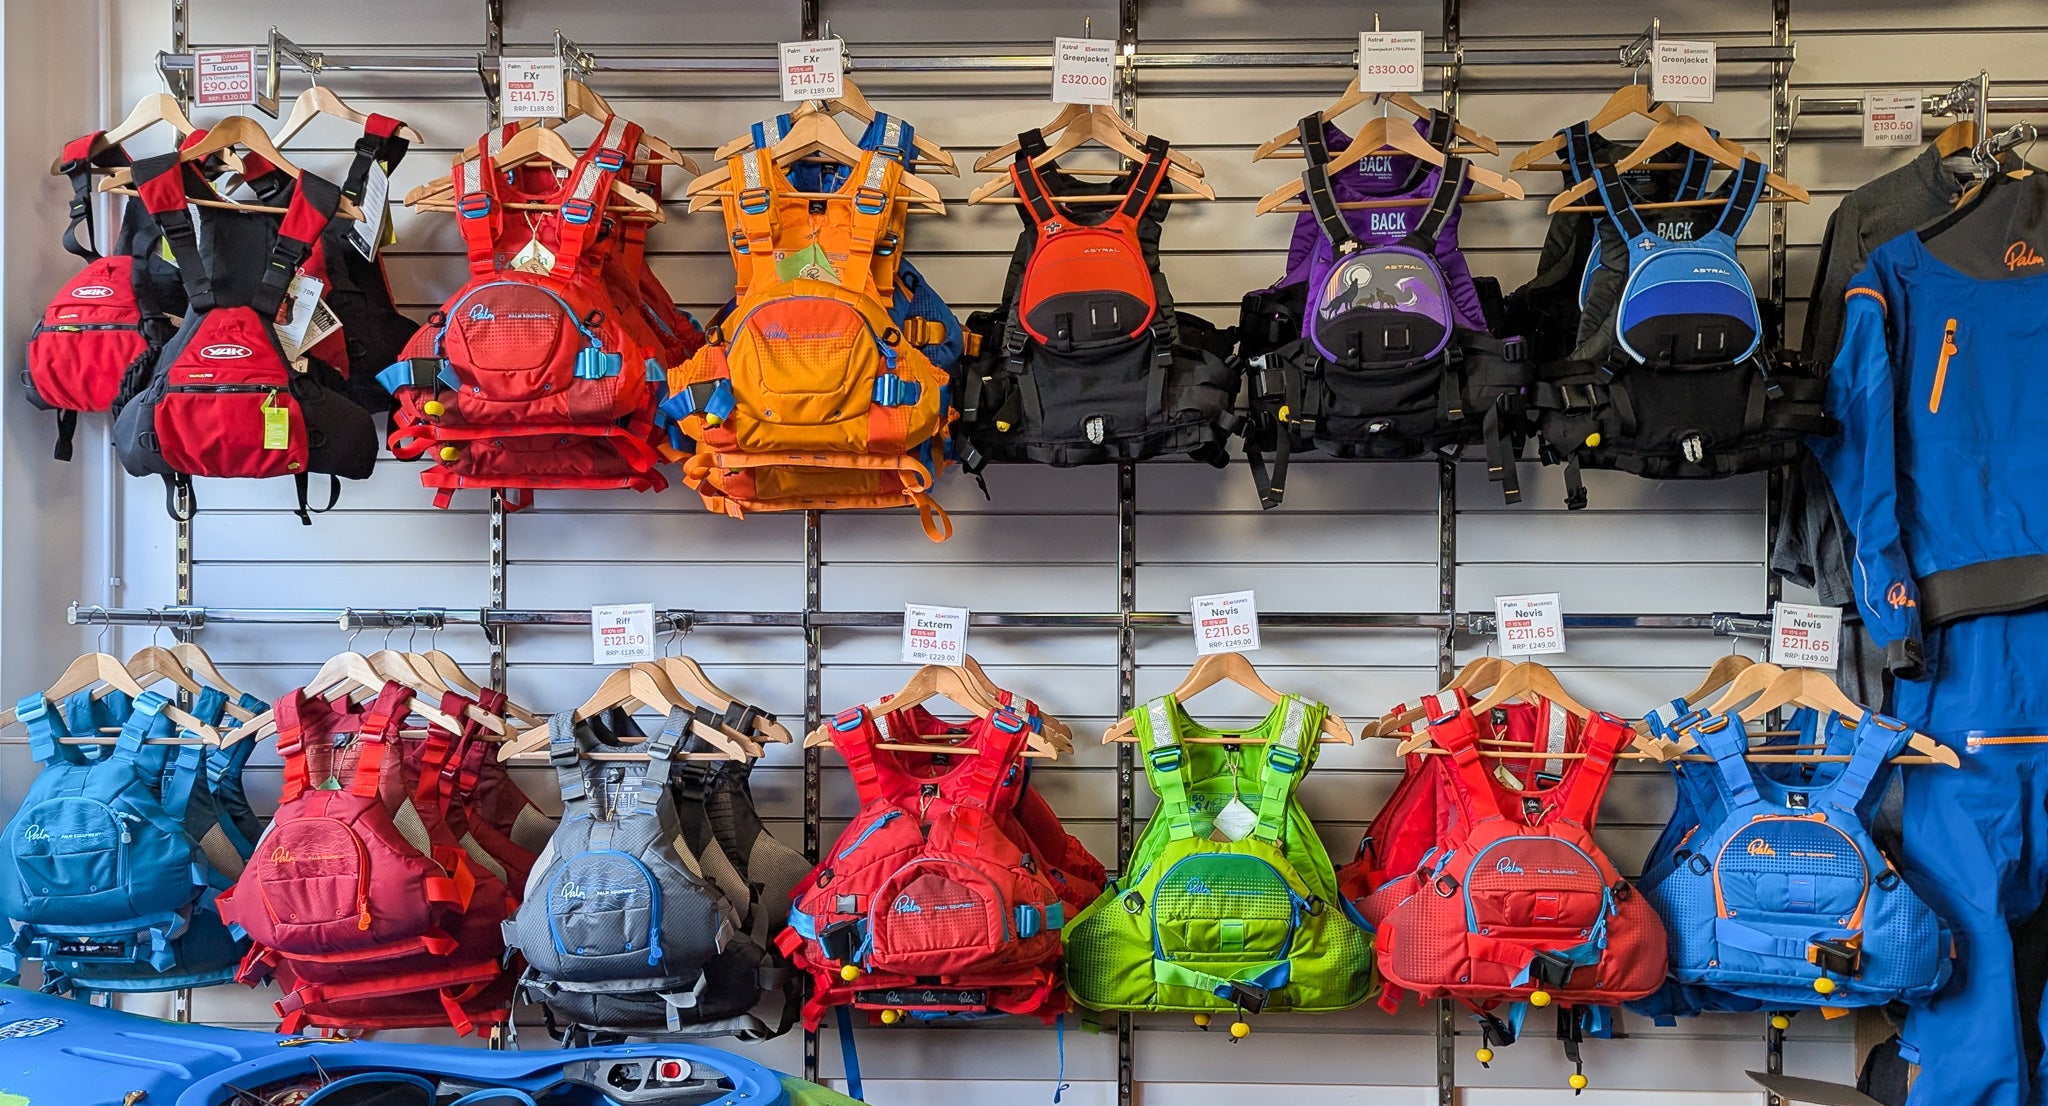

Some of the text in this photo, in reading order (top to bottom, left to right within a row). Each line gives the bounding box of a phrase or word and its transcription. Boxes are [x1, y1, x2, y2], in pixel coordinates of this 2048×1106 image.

[803, 55, 820, 63] FXr
[1062, 54, 1108, 63] Greenjacket
[1661, 56, 1709, 65] Greenjacket
[1368, 65, 1415, 74] £330.00
[524, 72, 540, 80] FXr
[790, 73, 835, 85] £141.75
[1061, 74, 1107, 86] £320.00
[1662, 75, 1707, 85] £320.00
[203, 81, 248, 92] £90.00
[511, 91, 554, 102] £141.75
[1874, 121, 1914, 131] £130.50
[1360, 156, 1393, 173] BACK
[1370, 213, 1406, 231] BACK
[1657, 222, 1693, 240] BACK
[2004, 241, 2045, 271] Palm
[78, 289, 107, 297] YAK
[470, 304, 495, 321] Palm
[208, 348, 245, 356] YAK
[1211, 607, 1239, 617] Nevis
[1515, 609, 1543, 618] Nevis
[616, 617, 631, 625] Riff
[917, 619, 953, 630] Extrem
[1793, 619, 1822, 629] Nevis
[1205, 624, 1249, 639] £211.65
[1508, 627, 1555, 640] £211.65
[604, 635, 644, 646] £121.50
[911, 638, 956, 650] £194.65
[1225, 639, 1252, 647] £249.00
[1529, 641, 1556, 649] £249.00
[1782, 637, 1830, 651] £211.65
[1784, 651, 1829, 662] RRP: £249.00
[25, 824, 50, 842] Palm
[1748, 838, 1776, 858] Palm
[272, 847, 296, 864] Palm
[1496, 857, 1524, 876] Palm
[562, 881, 586, 900] Palm
[895, 894, 923, 915] Palm
